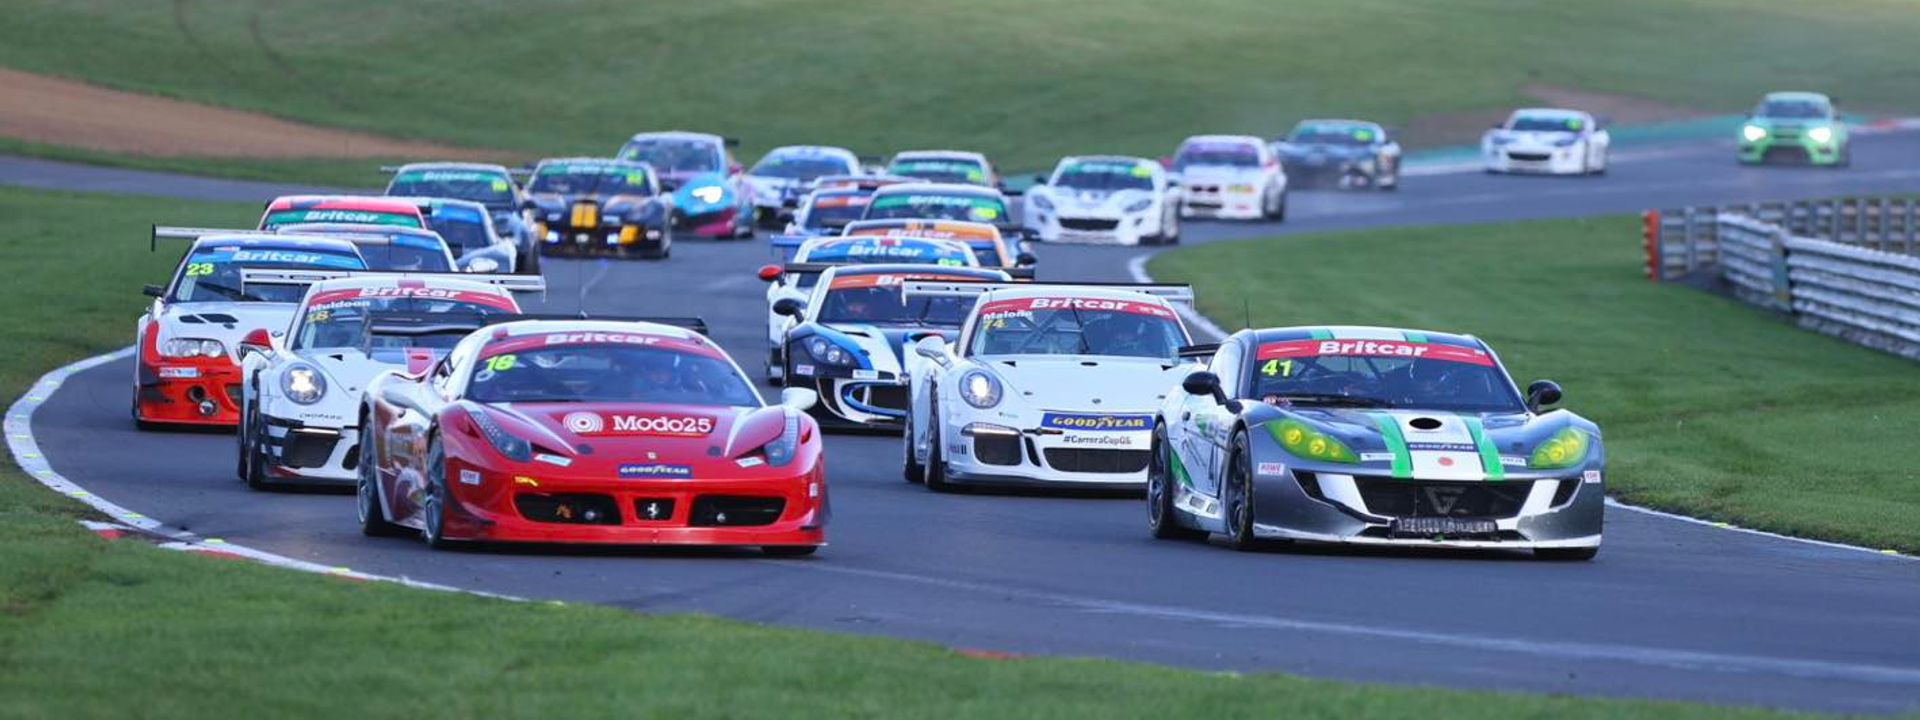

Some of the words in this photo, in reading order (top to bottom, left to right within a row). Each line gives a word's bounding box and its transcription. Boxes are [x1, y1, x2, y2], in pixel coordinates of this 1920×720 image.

[303, 210, 379, 222] Britcar
[232, 250, 323, 263] Britcar
[848, 244, 923, 257] Britcar
[185, 262, 214, 277] 23
[359, 286, 463, 299] Britcar
[1030, 298, 1130, 310] Britcar
[545, 333, 661, 345] Britcar
[1317, 341, 1429, 357] Britcar
[1261, 359, 1293, 377] 41
[612, 415, 712, 433] Modo25
